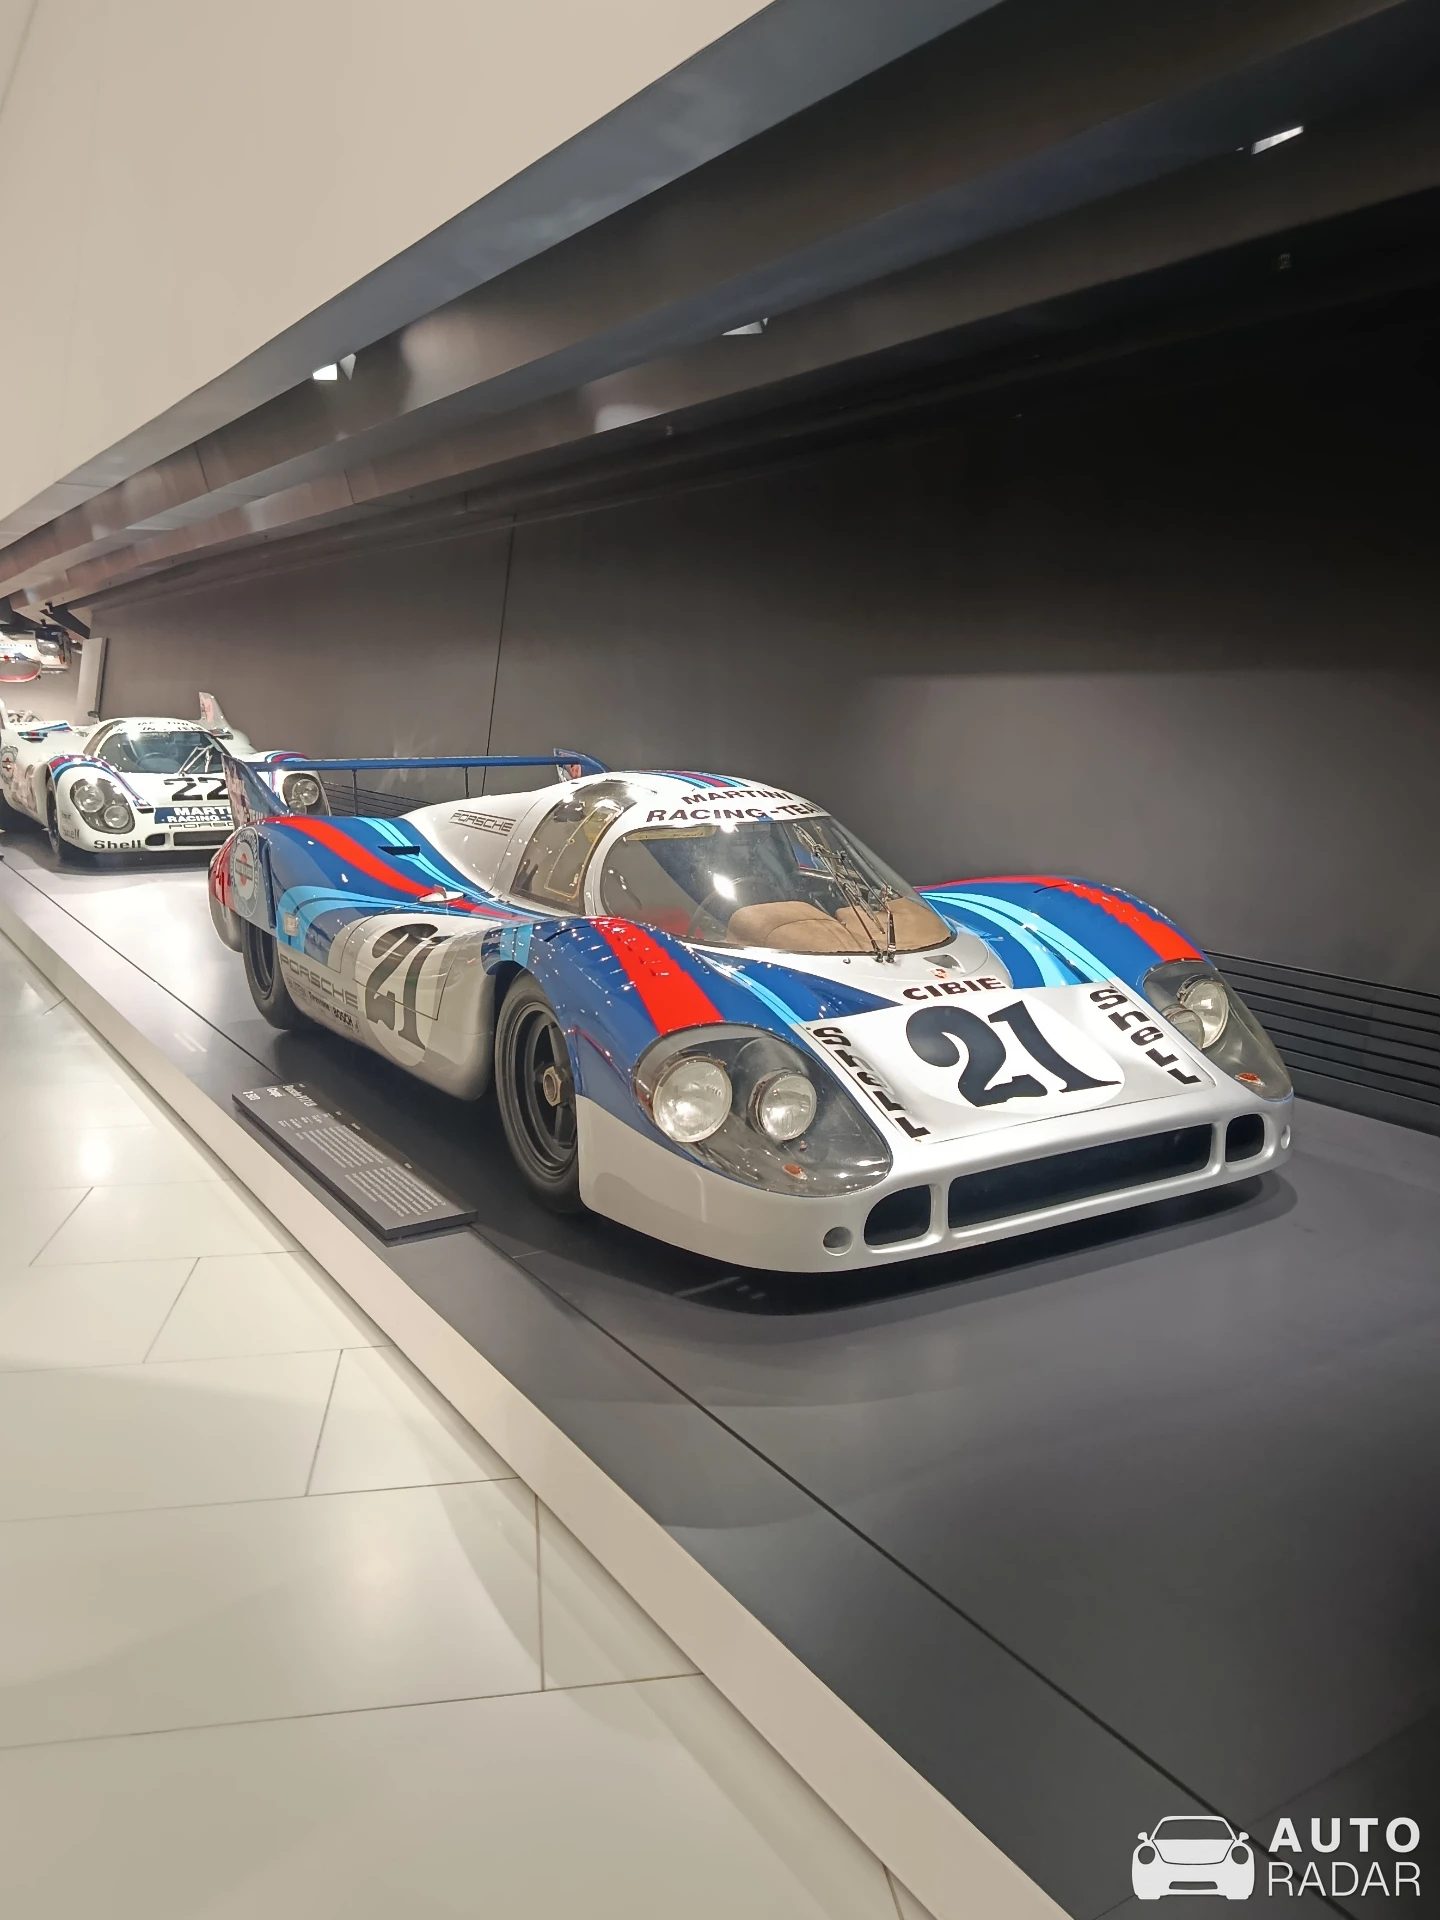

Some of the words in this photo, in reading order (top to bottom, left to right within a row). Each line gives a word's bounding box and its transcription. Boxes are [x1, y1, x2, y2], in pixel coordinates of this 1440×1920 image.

[164, 777, 229, 801] 22
[681, 790, 793, 805] MARTINI
[450, 812, 514, 832] PORSCHE
[94, 839, 141, 849] Shell
[279, 953, 359, 1010] PORSCHE
[365, 923, 456, 1050] 21
[903, 977, 1006, 1000] CIBIE
[905, 1000, 1122, 1107] 21
[1089, 988, 1202, 1085] Shell
[812, 1026, 931, 1139] Shell
